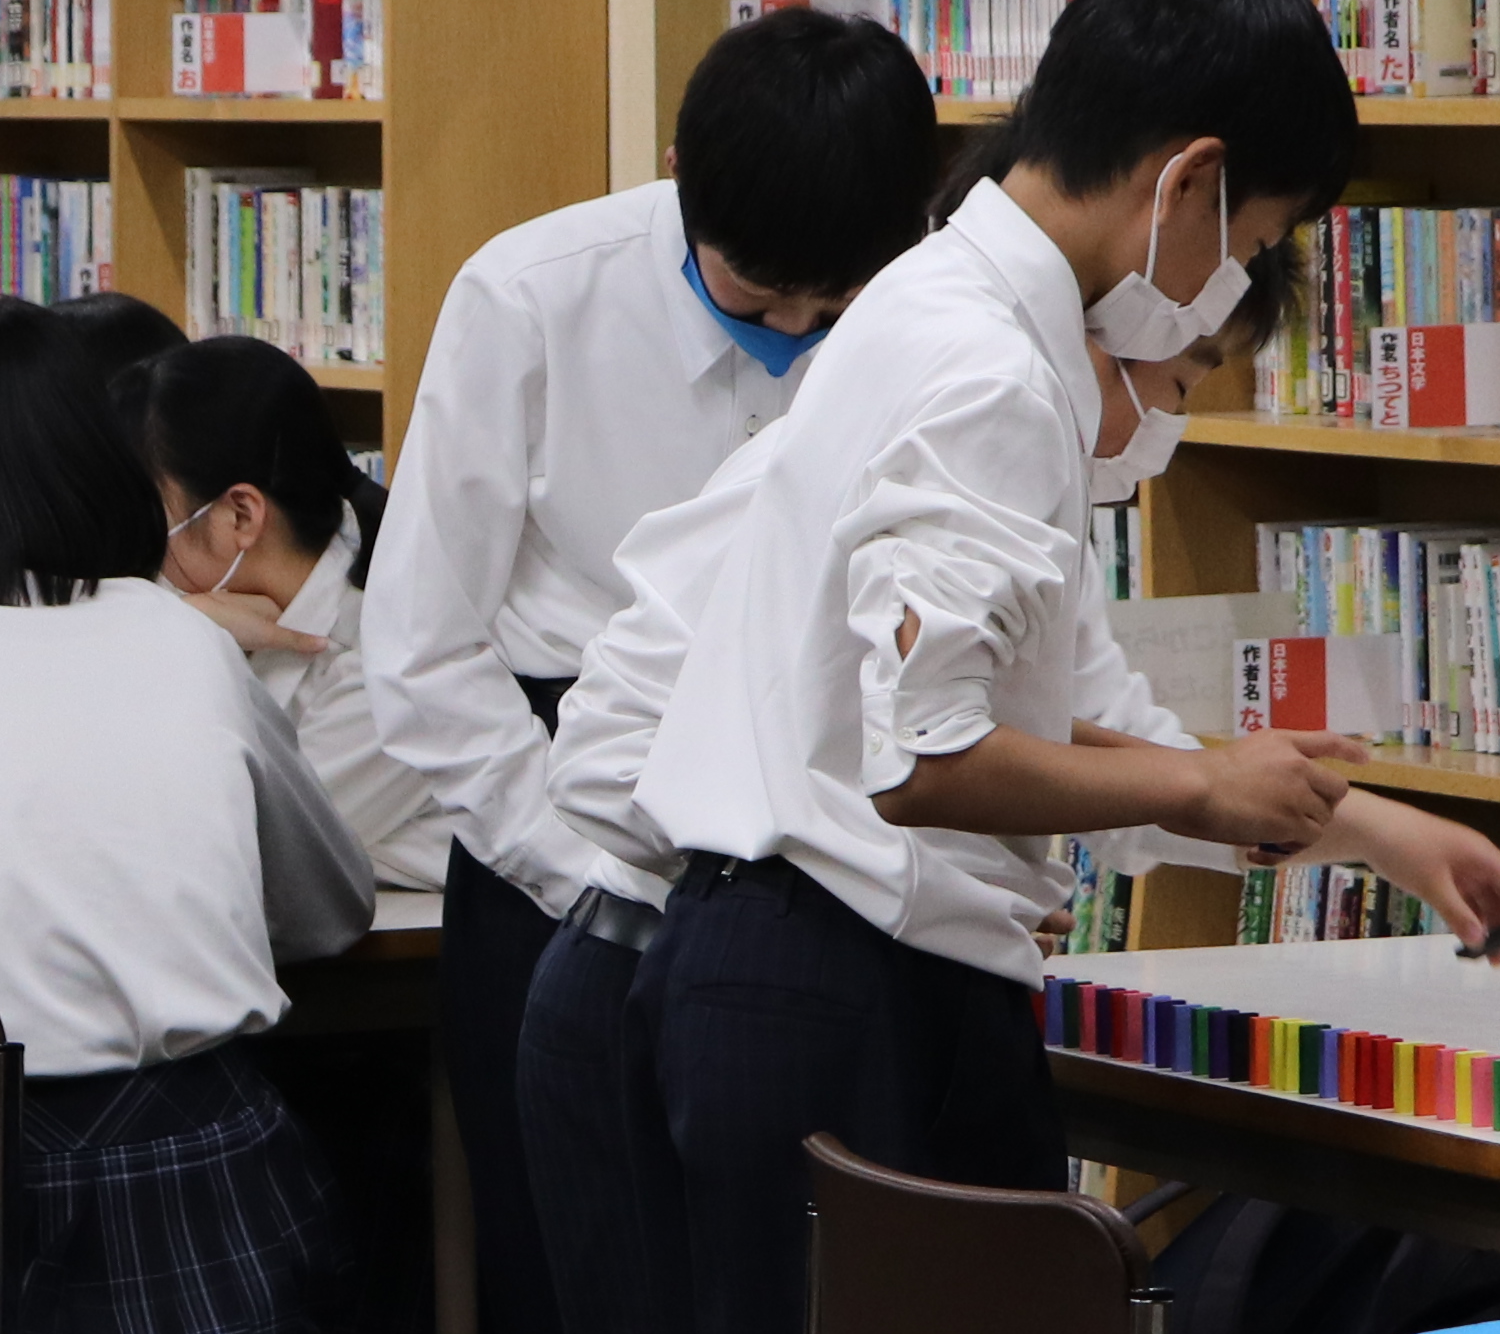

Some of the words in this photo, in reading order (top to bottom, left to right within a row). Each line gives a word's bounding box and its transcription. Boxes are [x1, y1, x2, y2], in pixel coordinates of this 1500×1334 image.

[178, 70, 196, 89] お
[1382, 55, 1404, 81] た
[1410, 332, 1427, 391] 日本文学
[1377, 366, 1403, 426] ちつてと
[1242, 644, 1261, 702] 作者名
[1272, 643, 1288, 701] 日本文学
[1239, 706, 1263, 732] な
